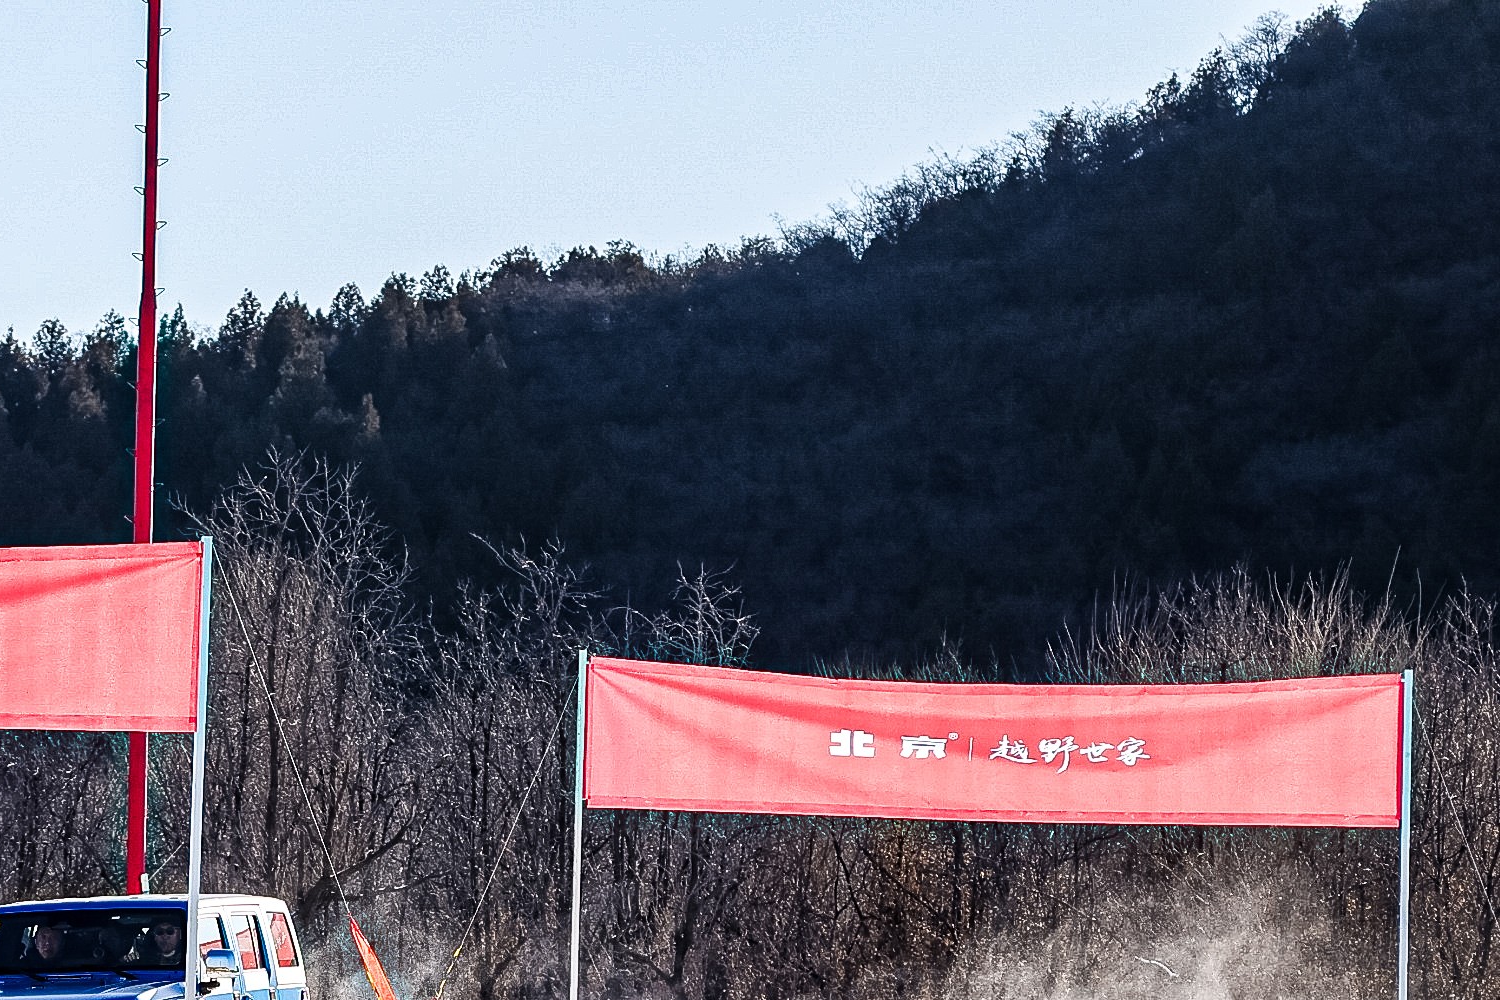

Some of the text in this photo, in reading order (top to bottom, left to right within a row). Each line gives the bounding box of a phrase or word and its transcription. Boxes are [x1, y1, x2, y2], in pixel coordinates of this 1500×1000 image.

[828, 729, 1152, 775] 北京 越野世家
